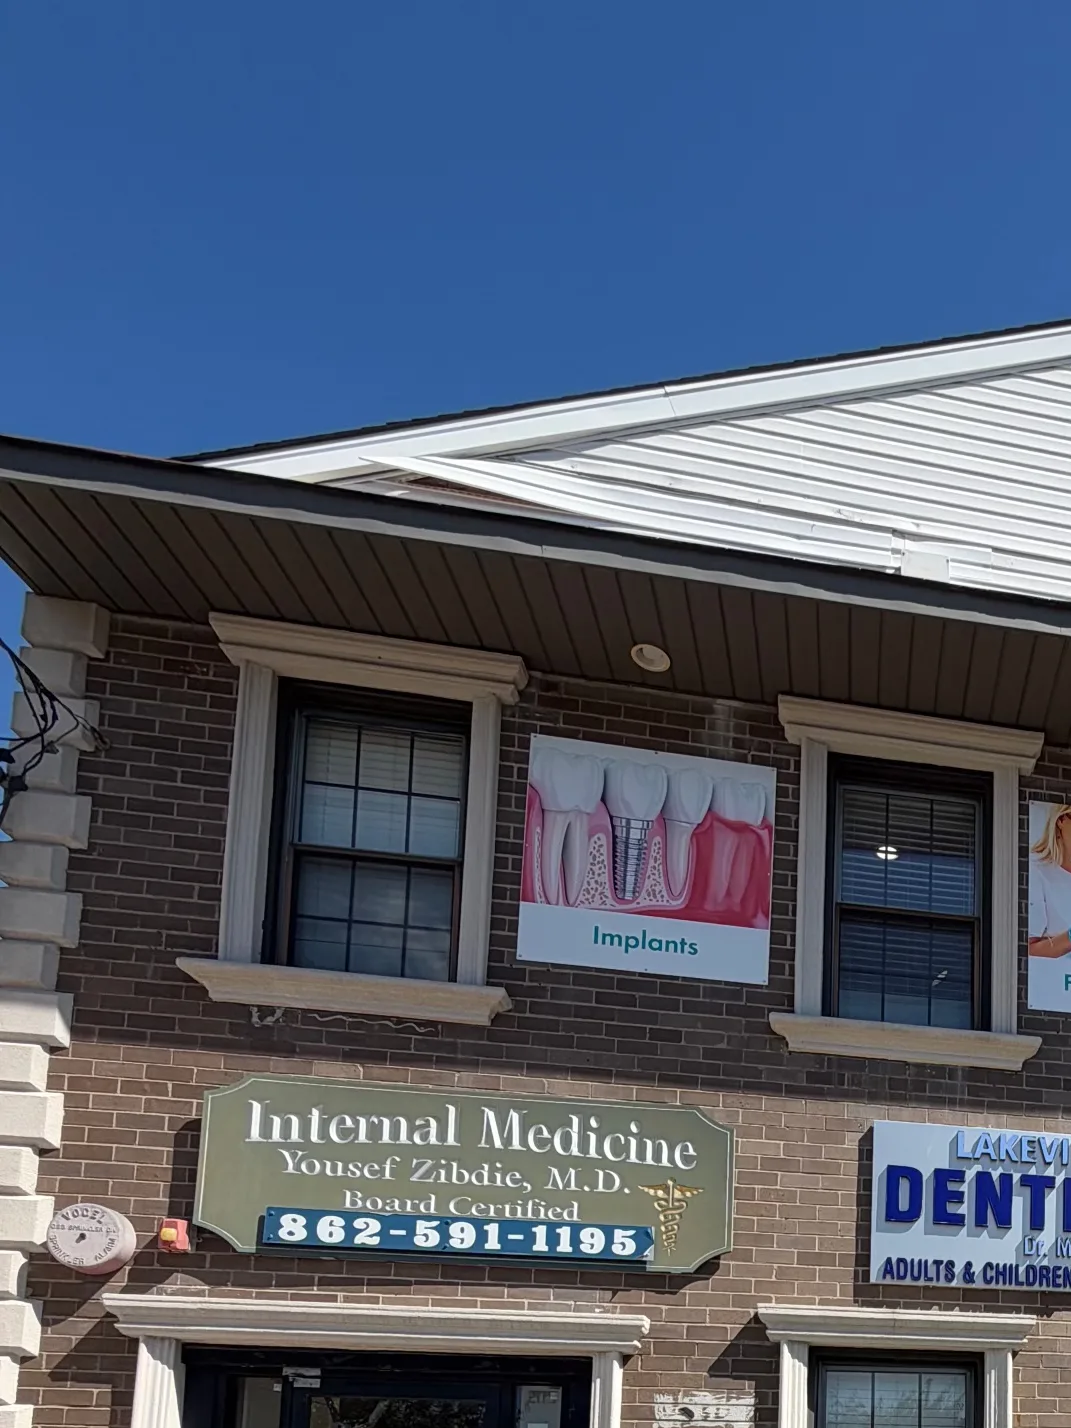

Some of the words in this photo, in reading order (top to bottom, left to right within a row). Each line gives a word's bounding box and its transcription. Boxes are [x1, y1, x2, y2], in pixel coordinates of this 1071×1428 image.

[593, 925, 698, 956] Implants
[244, 1099, 461, 1147] Internal
[477, 1106, 698, 1171] Medicine
[277, 1148, 402, 1181] Yousef
[409, 1157, 532, 1193] Zibdie,
[546, 1166, 631, 1194] M.D.
[342, 1189, 437, 1214] Board
[447, 1196, 582, 1223] Certified
[276, 1213, 637, 1256] 862-591-1195
[1023, 1235, 1048, 1257] Dr.
[882, 1257, 956, 1284] ADULTS
[963, 1261, 976, 1284] &
